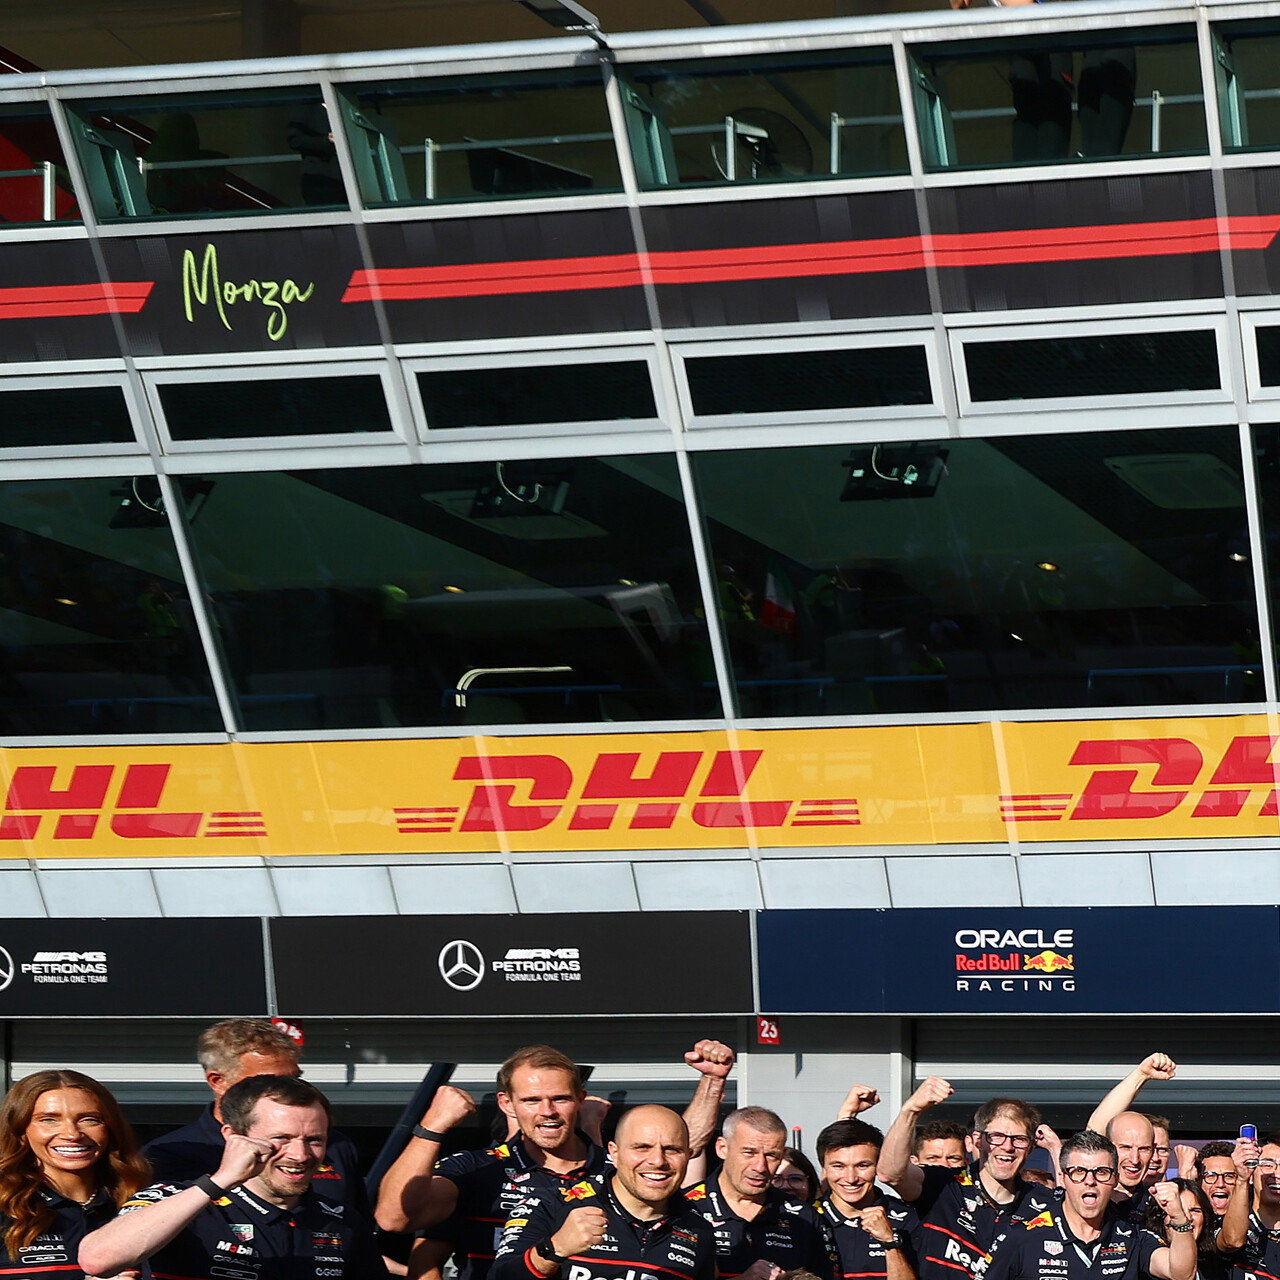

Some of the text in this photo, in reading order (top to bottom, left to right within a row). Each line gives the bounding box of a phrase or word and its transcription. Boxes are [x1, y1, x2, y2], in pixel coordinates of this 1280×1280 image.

[181, 243, 314, 341] Monza
[452, 750, 795, 832] DHL
[955, 929, 1074, 949] ORACLE
[530, 948, 580, 959] AMG
[21, 963, 108, 974] PETRONAS
[492, 961, 580, 971] PETRONAS
[33, 975, 108, 983] FORMULA ONE TEAM
[505, 973, 581, 981] FORMULA ONE TEAM
[956, 980, 1076, 992] RACING
[760, 1020, 779, 1039] 23
[18, 1244, 65, 1252] ORACLE
[213, 1254, 263, 1269] ORACLE
